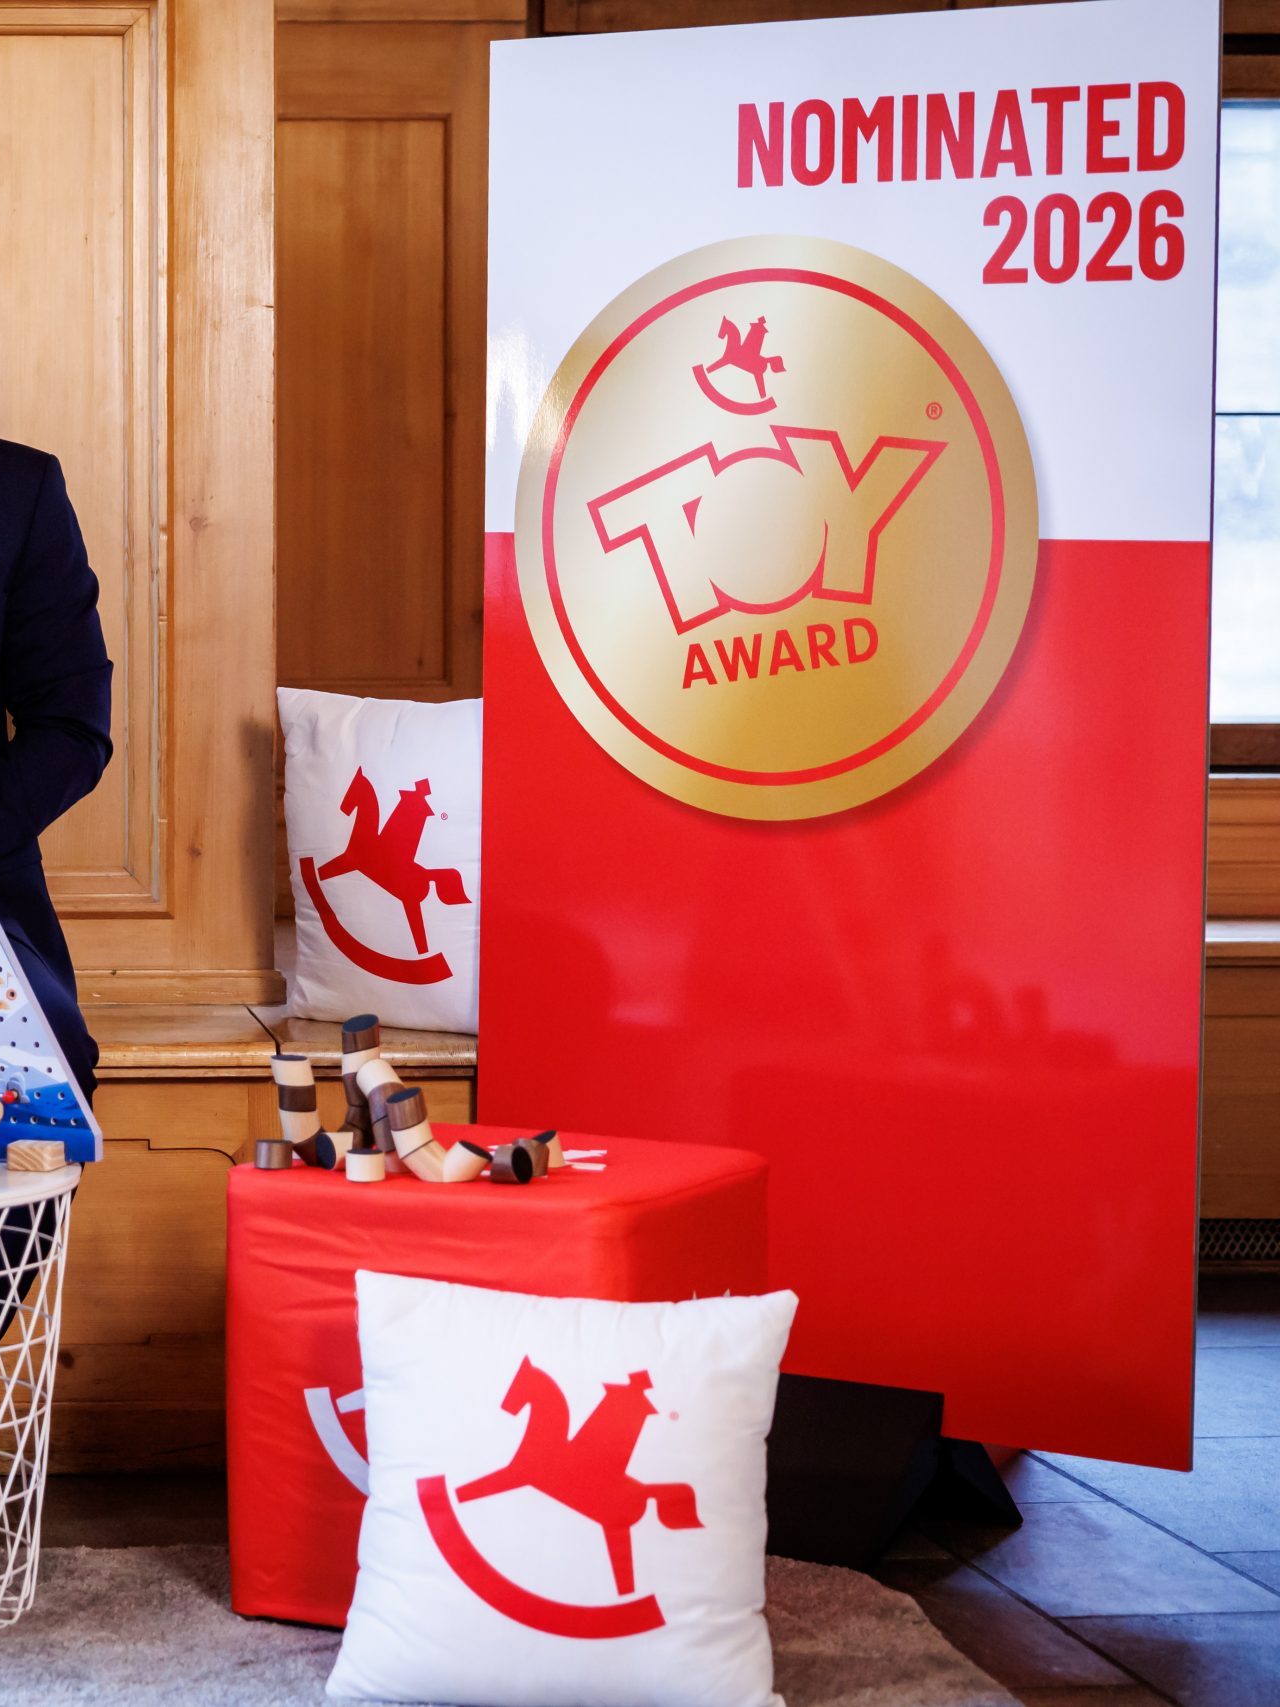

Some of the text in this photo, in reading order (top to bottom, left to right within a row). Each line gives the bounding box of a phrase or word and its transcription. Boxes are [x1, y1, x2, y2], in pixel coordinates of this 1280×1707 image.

[738, 81, 1186, 187] NOMINATED
[982, 190, 1185, 284] 2026
[587, 425, 949, 635] TOY
[681, 617, 879, 689] AWARD
